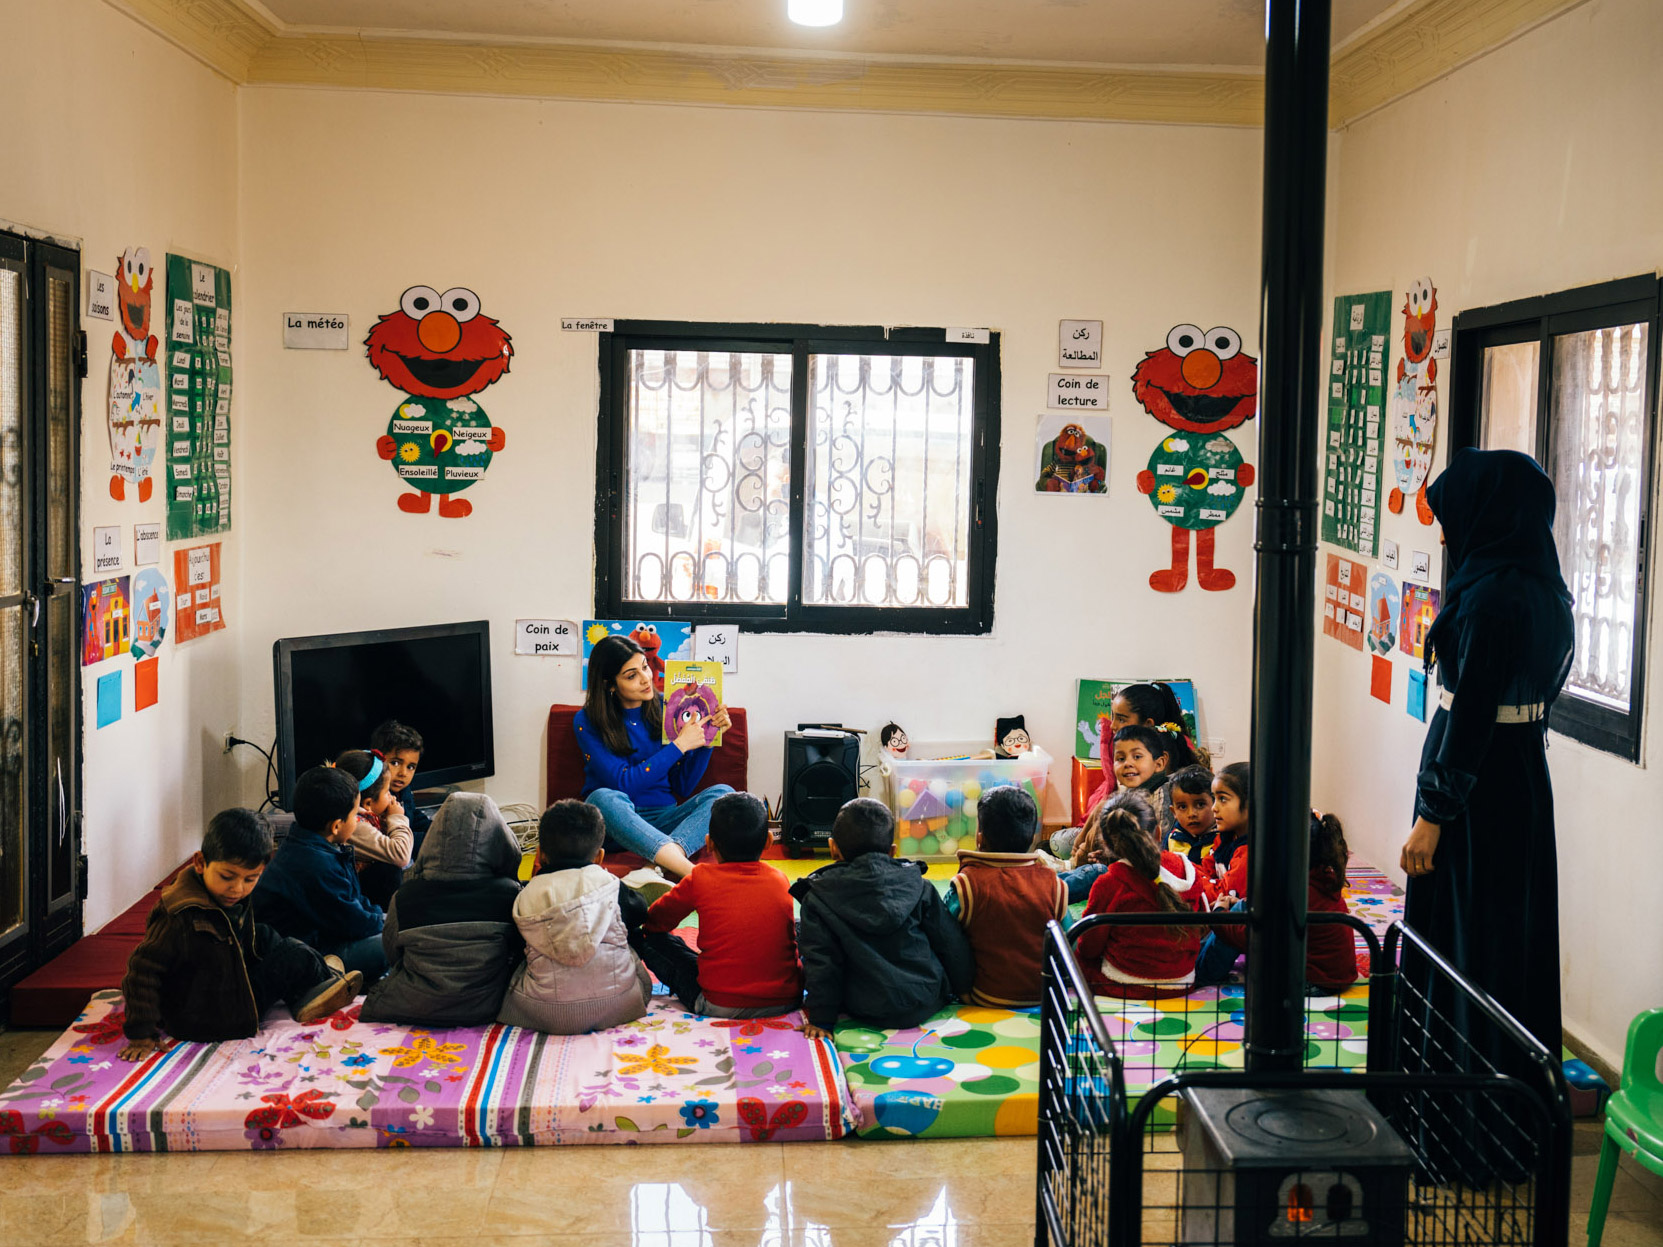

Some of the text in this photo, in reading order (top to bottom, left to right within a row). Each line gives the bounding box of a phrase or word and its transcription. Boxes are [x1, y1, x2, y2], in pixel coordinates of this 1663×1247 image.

[199, 271, 206, 282] Le
[97, 278, 105, 293] Les
[91, 300, 109, 316] saisons
[287, 317, 344, 329] La météo
[562, 321, 608, 330] La fenêtre
[1072, 328, 1090, 340] ركن
[1062, 348, 1098, 361] المطالعة
[1057, 378, 1099, 390] Coin de
[1057, 395, 1098, 407] lecture
[393, 423, 430, 434] Nuageux
[453, 429, 487, 440] Neigeux
[399, 467, 438, 477] Ensoleillé
[445, 469, 479, 479] Pluvieux
[104, 532, 112, 545] La
[96, 555, 120, 572] présence
[525, 624, 569, 635] Coin de
[708, 633, 726, 645] ركن
[535, 642, 559, 654] paix
